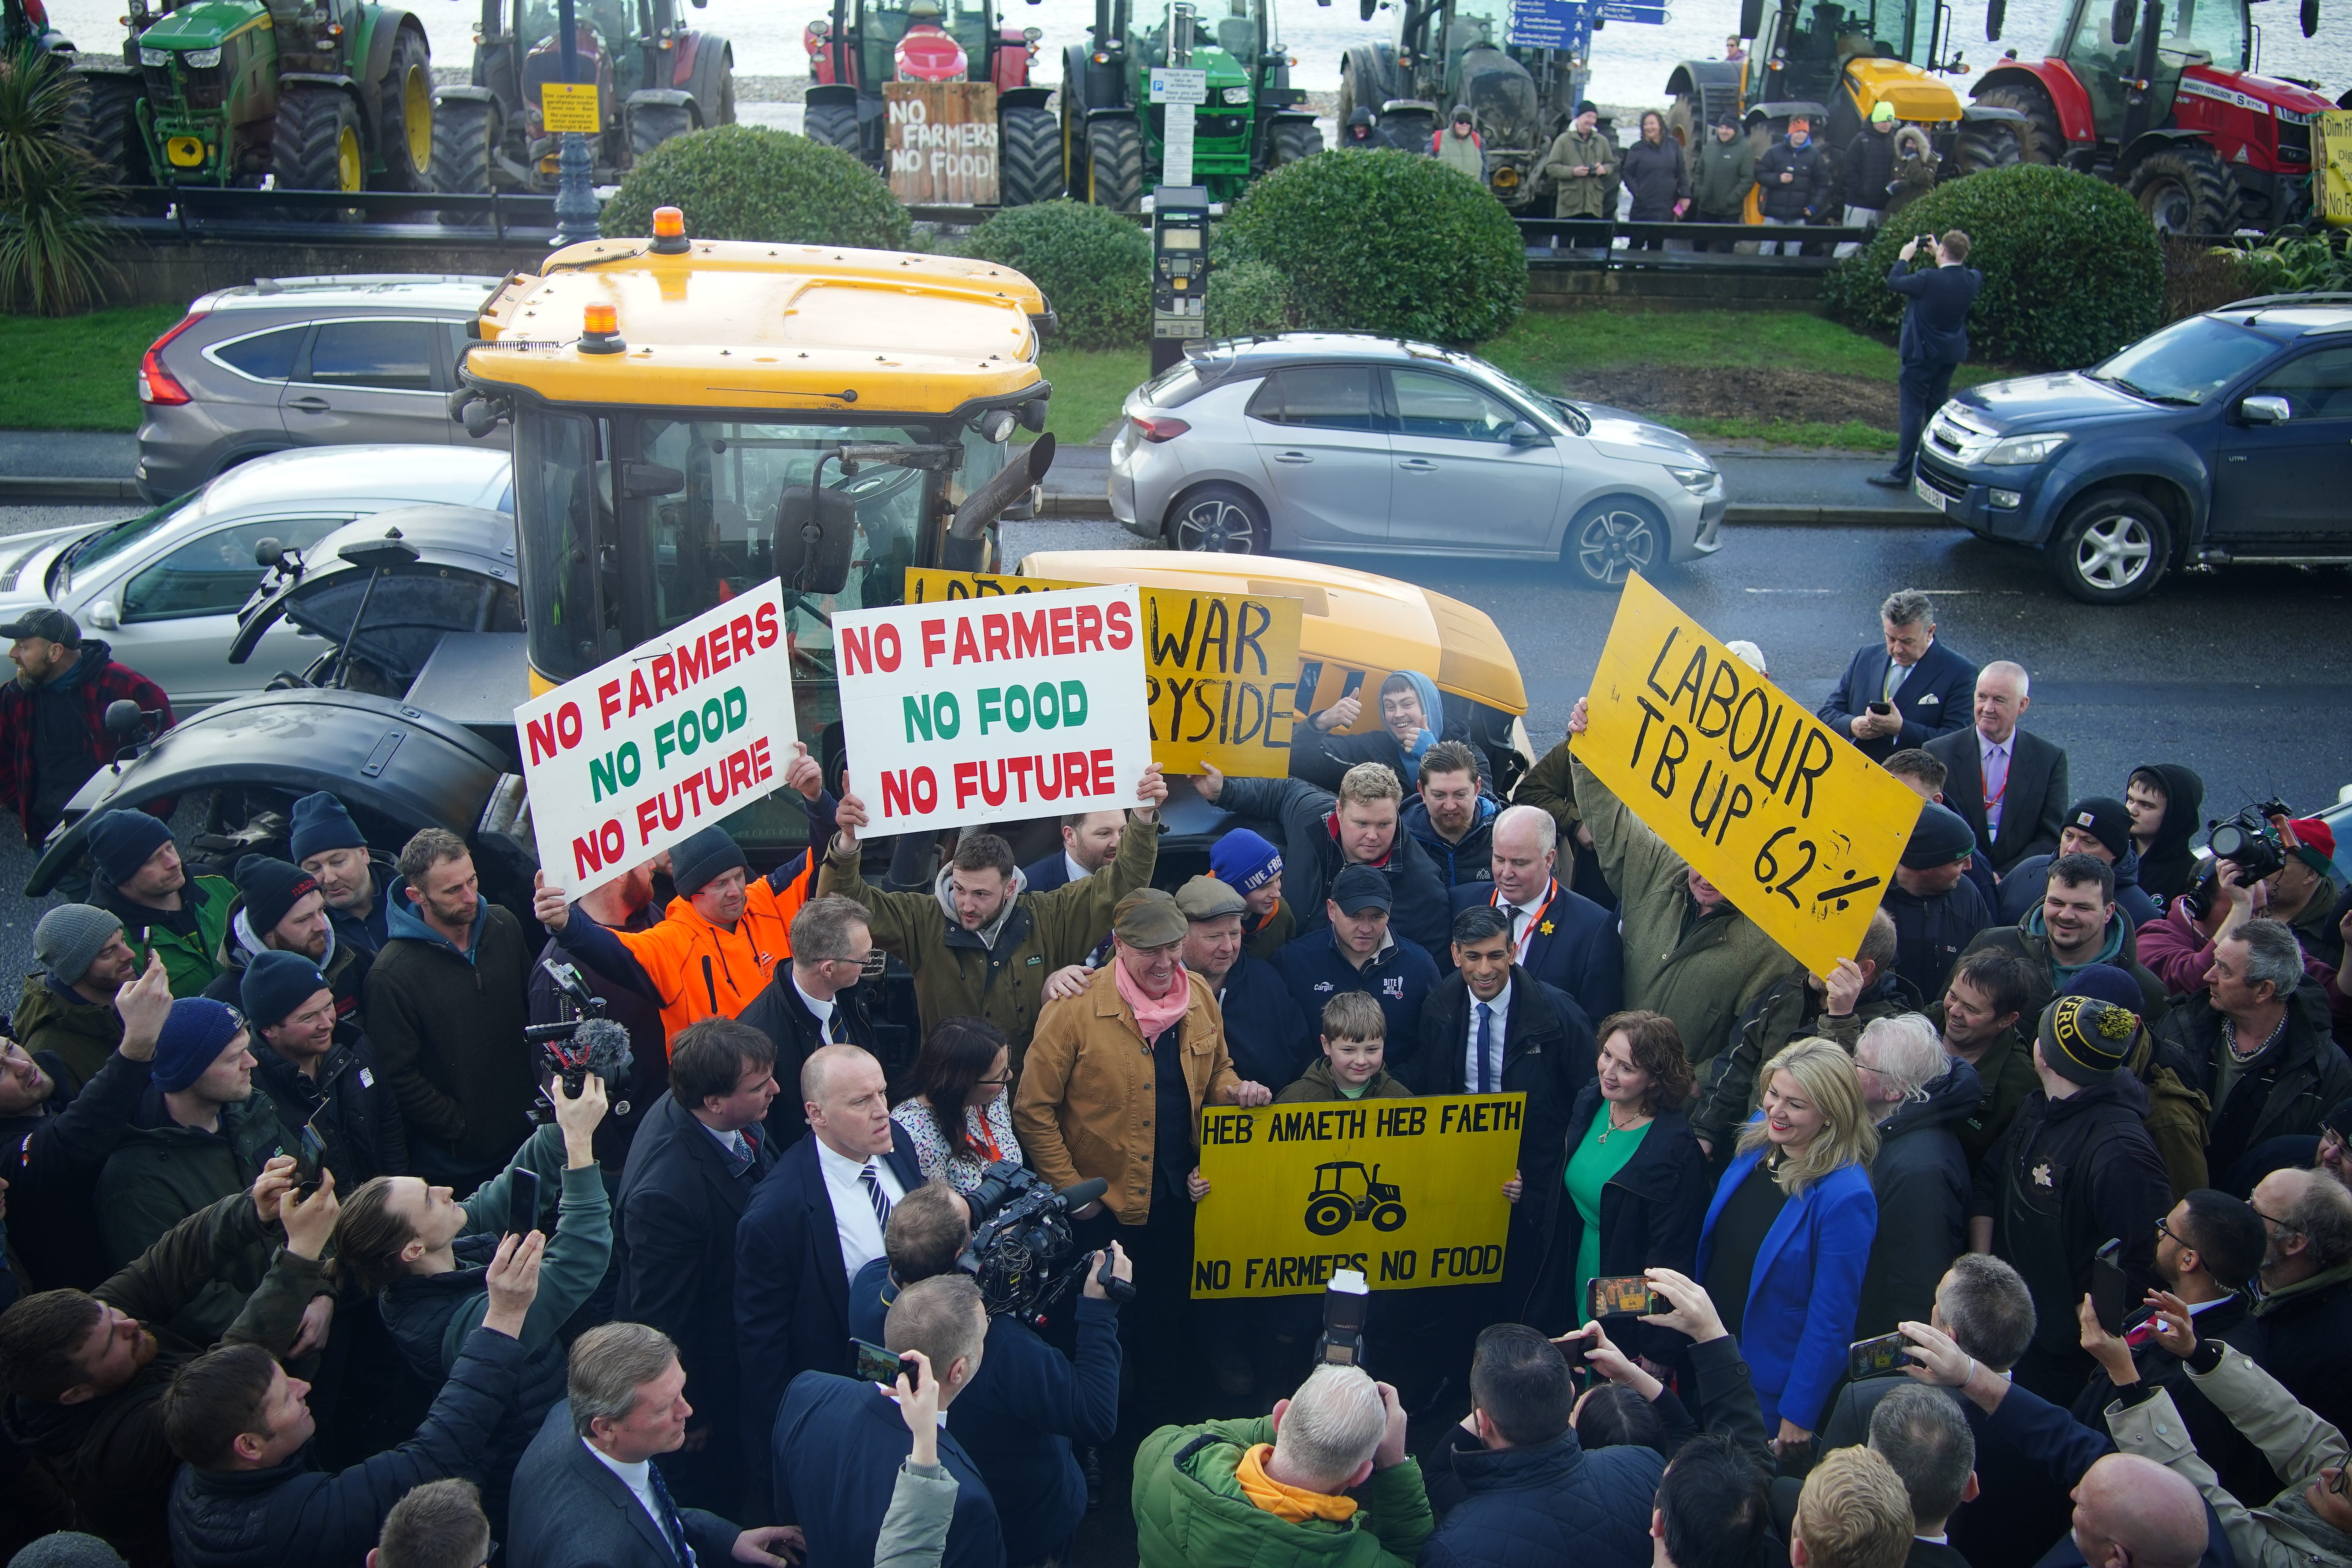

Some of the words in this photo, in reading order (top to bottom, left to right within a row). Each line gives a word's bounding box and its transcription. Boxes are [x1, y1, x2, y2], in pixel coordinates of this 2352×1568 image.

[889, 99, 926, 124] NO
[2183, 82, 2204, 93] MASSEY
[2205, 86, 2232, 100] FERGUSON
[2237, 95, 2244, 105] S
[903, 123, 999, 148] FARMERS
[2326, 117, 2342, 137] Dim
[892, 149, 922, 172] NO
[930, 151, 995, 181] FOOD!
[2329, 192, 2342, 215] No
[842, 623, 901, 676] NO
[921, 601, 1134, 668] FARMERS
[1150, 596, 1271, 676] WAR
[526, 702, 583, 766] NO
[598, 602, 779, 731] FARMERS
[904, 691, 960, 744] NO
[977, 680, 1088, 735] FOOD
[1647, 626, 1833, 818] LABOUR
[589, 741, 641, 803] NO
[654, 686, 747, 770] FOOD
[881, 766, 937, 818] NO
[955, 748, 1115, 809] FUTURE
[1631, 696, 1688, 799] TB
[1691, 759, 1753, 846] UP
[572, 819, 624, 881] NO
[636, 736, 773, 846] FUTURE
[1245, 869, 1269, 890] LIVE
[1314, 984, 1334, 992] Cargill
[1203, 1114, 1253, 1145] HEB
[1268, 1109, 1366, 1142] AMAETH
[1376, 1107, 1427, 1138] HEB
[1440, 1101, 1521, 1134] FAETH
[1196, 1260, 1231, 1291] NO
[1380, 1250, 1417, 1282] NO
[1431, 1245, 1503, 1278] FOOD
